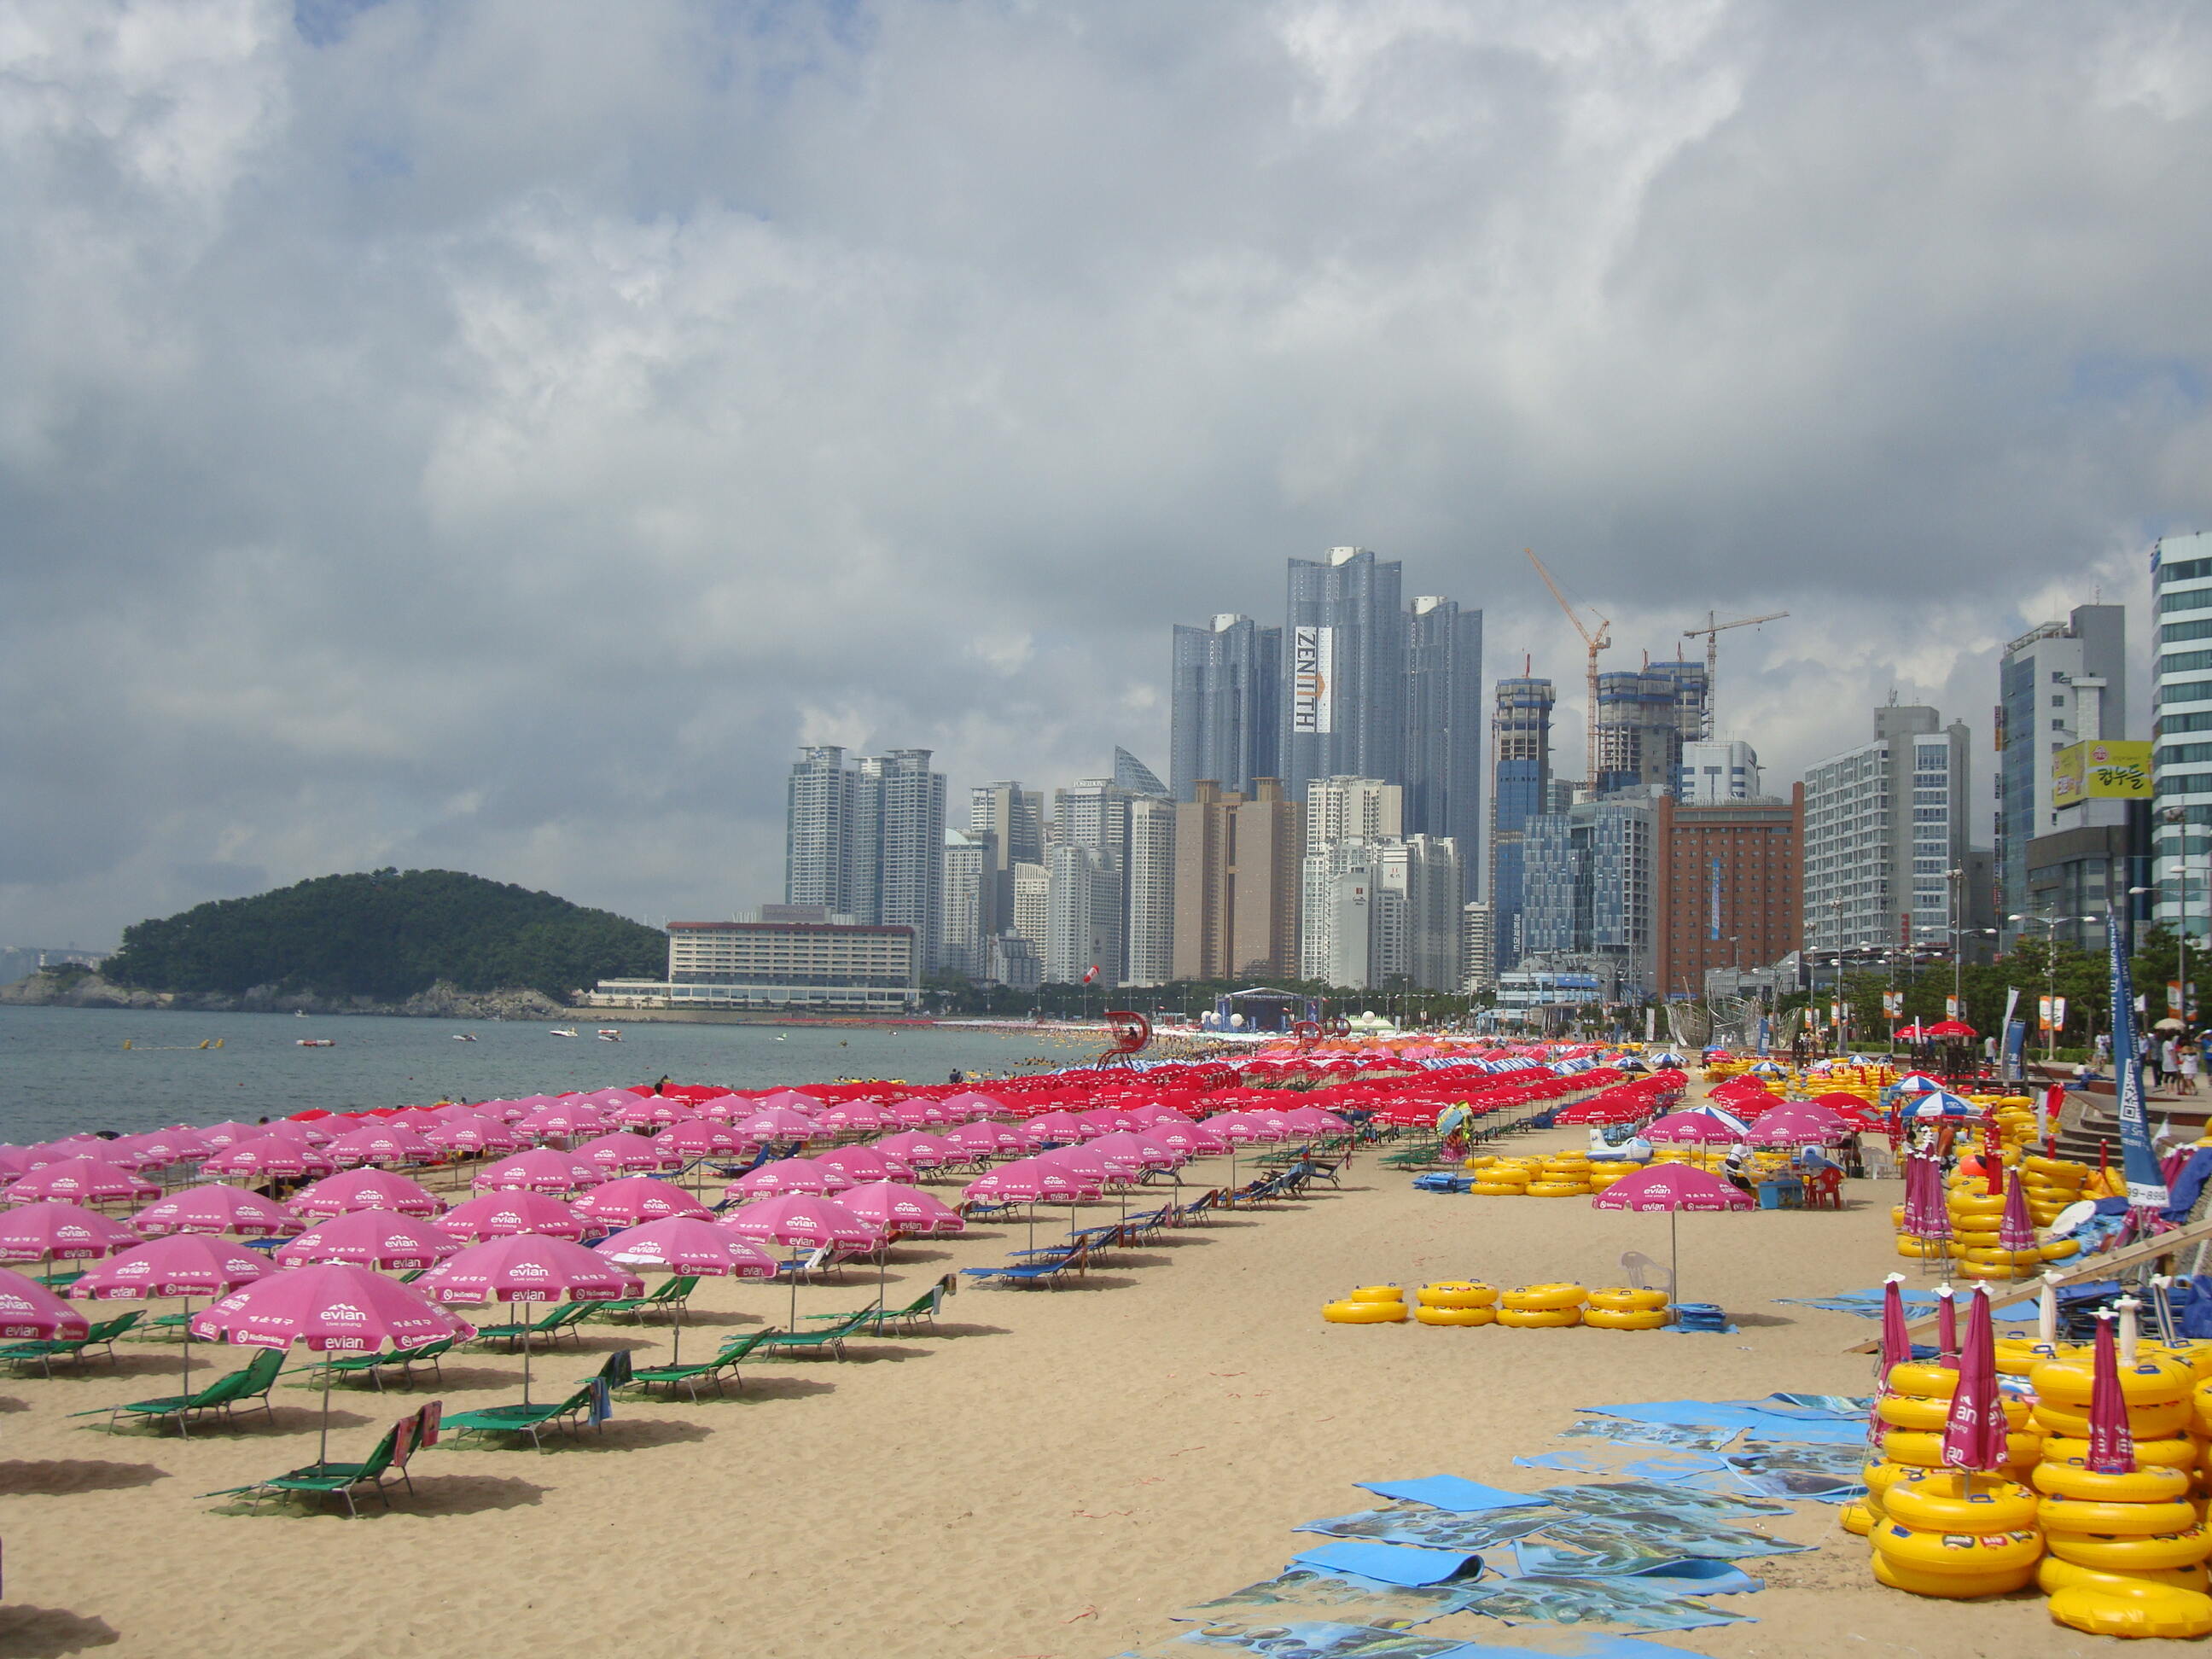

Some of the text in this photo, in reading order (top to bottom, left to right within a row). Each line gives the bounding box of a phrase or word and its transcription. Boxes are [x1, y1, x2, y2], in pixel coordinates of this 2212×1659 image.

[1297, 632, 1316, 727] ZENITH
[2097, 764, 2145, 790] 컵누들
[1644, 1186, 1671, 1195] evian
[643, 1201, 672, 1209] evian
[1642, 1202, 1665, 1211] evian
[491, 1215, 522, 1225] evian
[786, 1220, 818, 1228] evian
[899, 1221, 923, 1230] evian
[57, 1229, 91, 1237] evian
[386, 1239, 418, 1248] evian
[789, 1237, 816, 1246] evian
[64, 1249, 93, 1258] evian
[628, 1244, 661, 1254] evian
[225, 1262, 260, 1272] evian
[393, 1258, 421, 1268] evian
[116, 1266, 151, 1275] evian
[509, 1268, 549, 1278] evian
[742, 1266, 763, 1276] evian
[110, 1287, 137, 1297] evian
[512, 1289, 546, 1301] evian
[320, 1310, 368, 1321] evian
[5, 1324, 39, 1337] evian
[325, 1336, 365, 1349] evian
